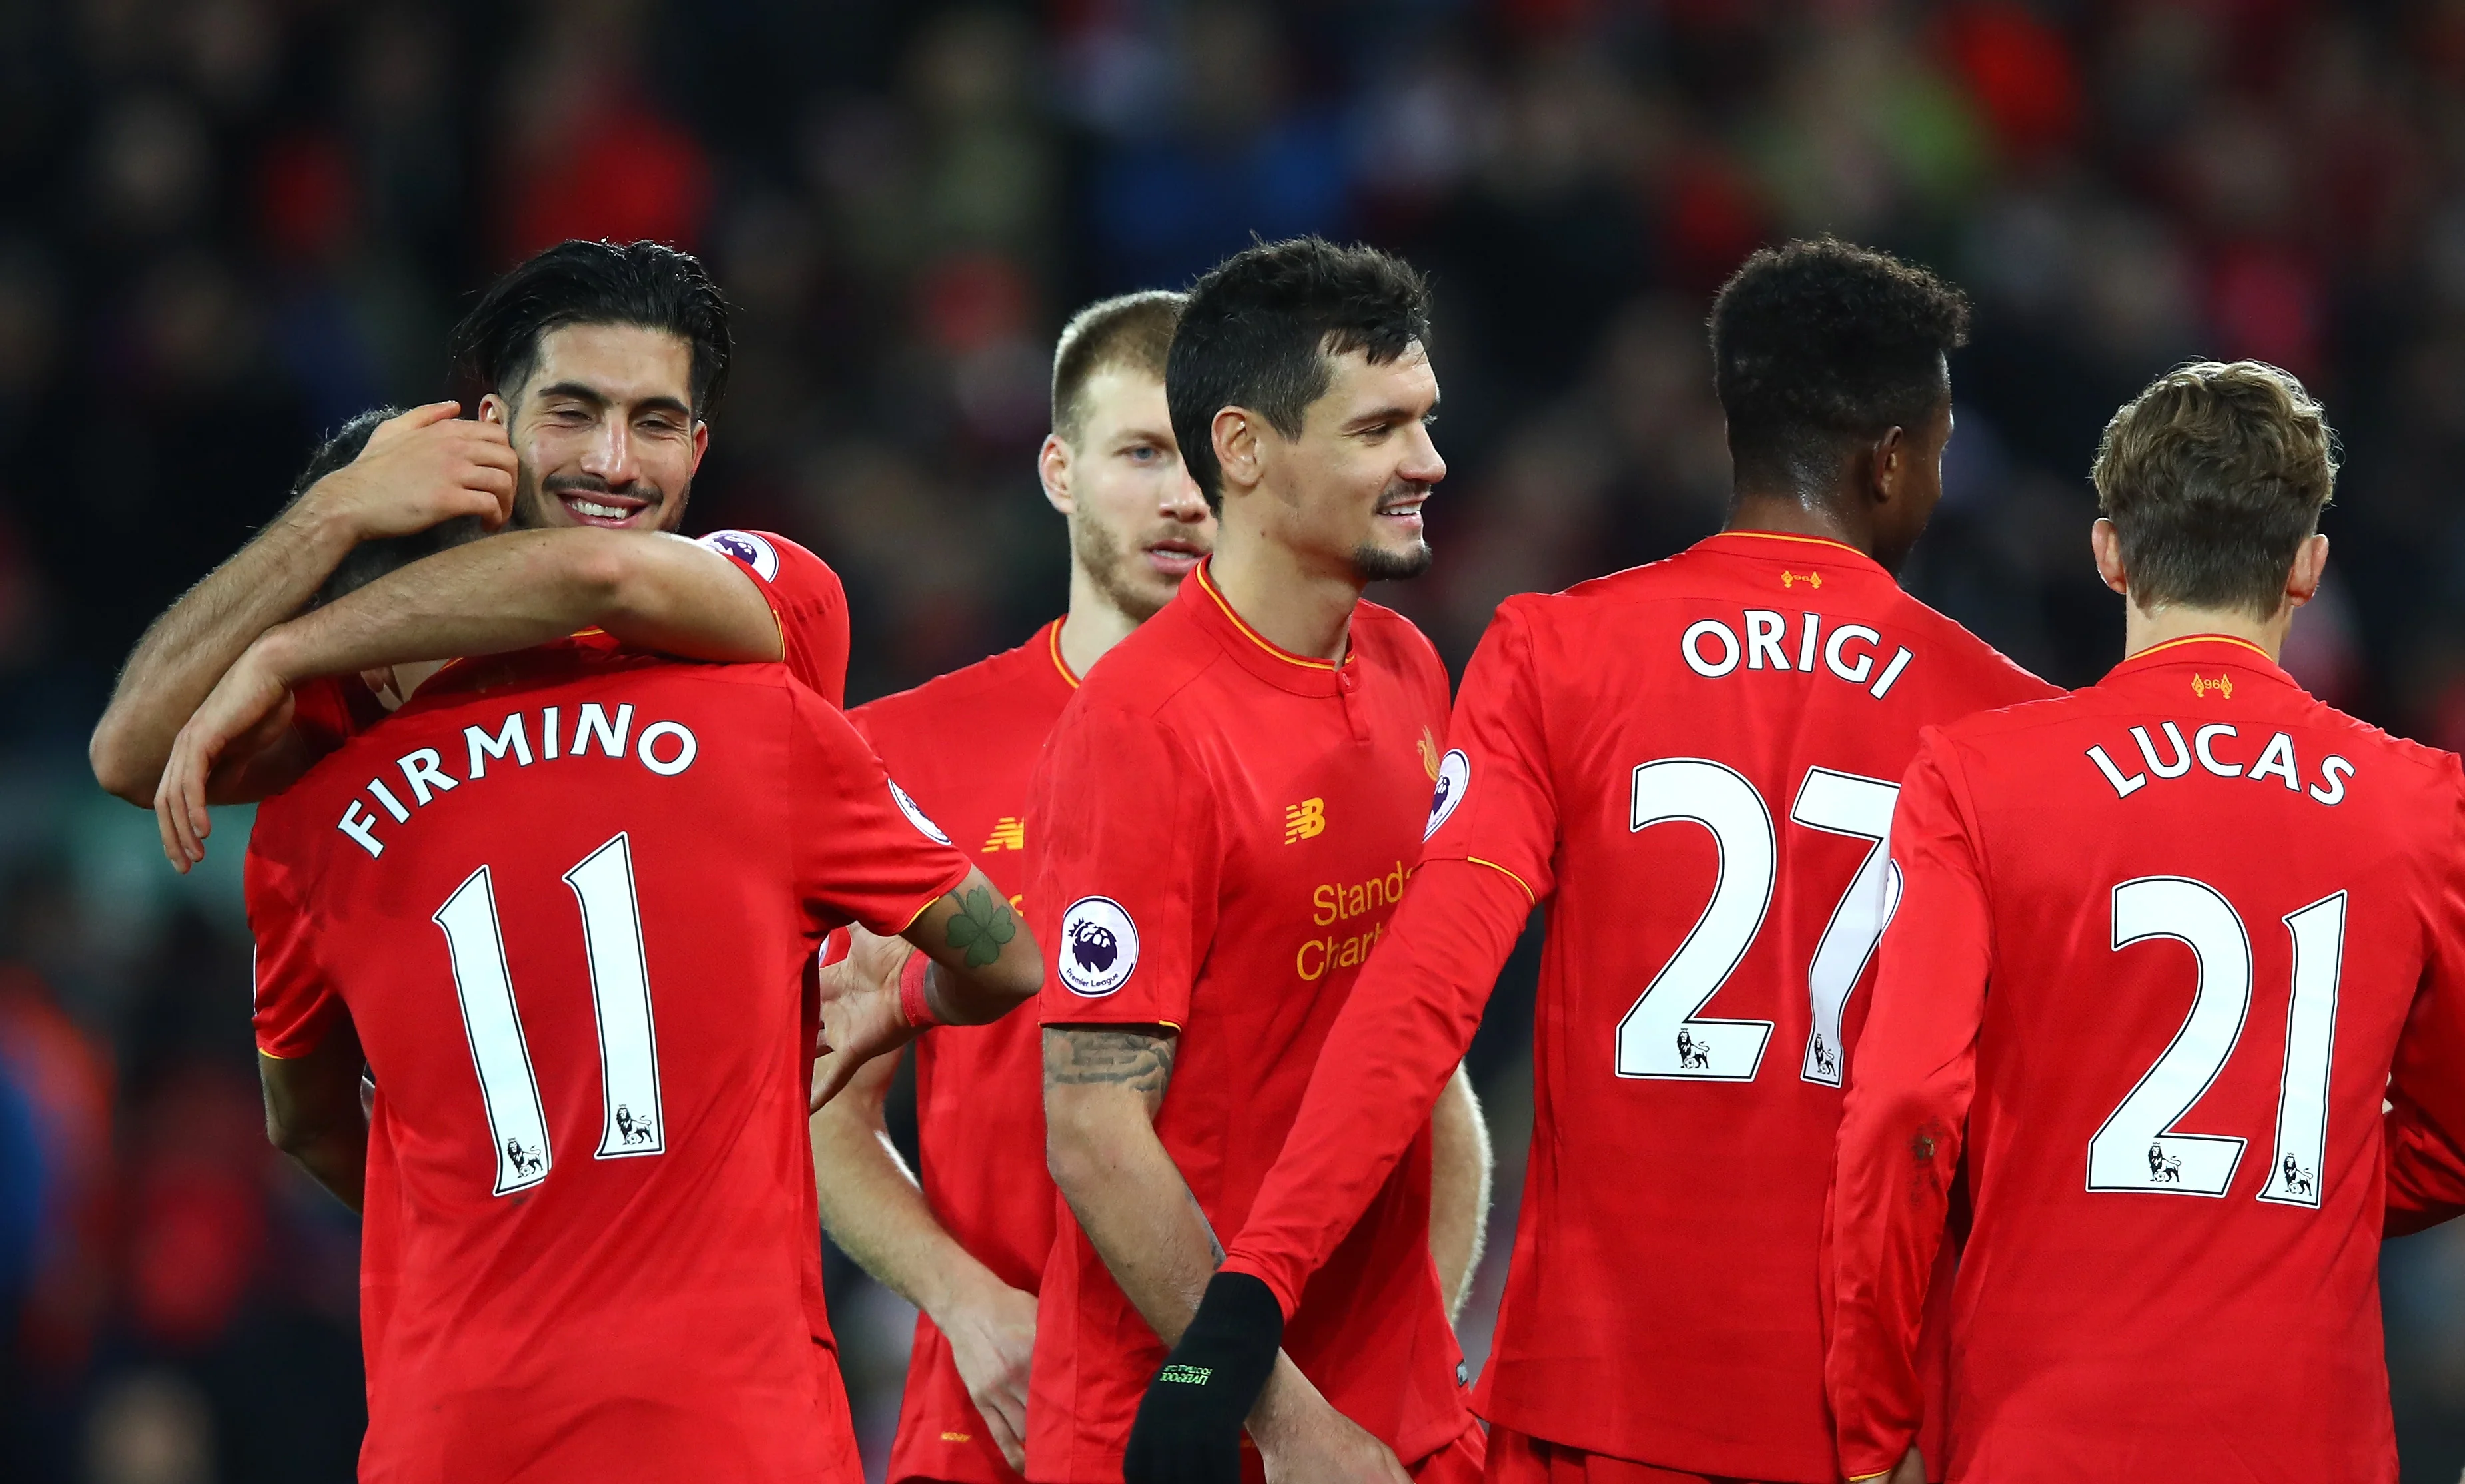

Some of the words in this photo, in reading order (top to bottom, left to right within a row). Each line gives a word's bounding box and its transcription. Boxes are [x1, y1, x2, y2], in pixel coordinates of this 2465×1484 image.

[1681, 609, 1913, 700] ORIGI
[2203, 679, 2221, 689] 96
[336, 703, 698, 859] FIRMINO
[2085, 721, 2356, 806] LUCAS
[1312, 859, 1413, 927] Stand
[1614, 756, 1905, 1089] 27
[430, 830, 666, 1198] 11
[1066, 968, 1089, 987] Premier
[1091, 973, 1119, 987] League
[2084, 874, 2348, 1210] 21
